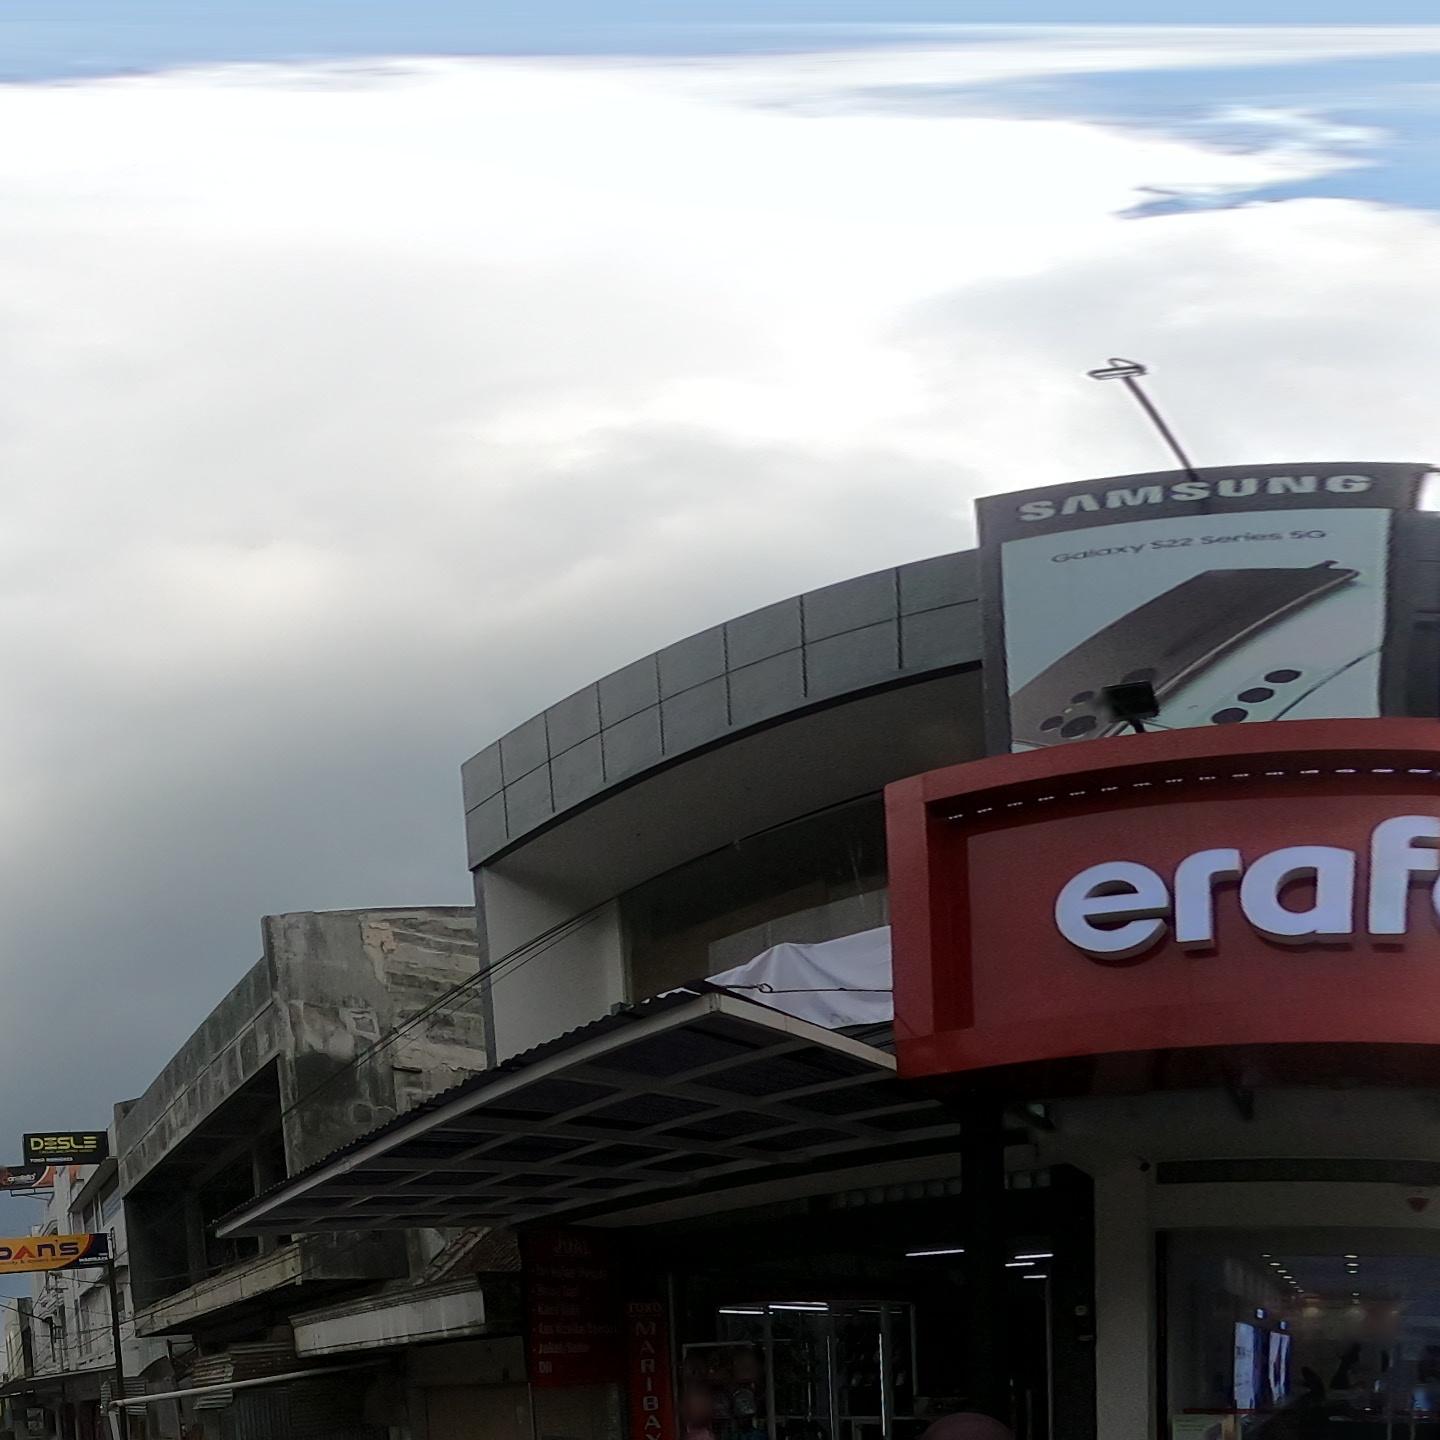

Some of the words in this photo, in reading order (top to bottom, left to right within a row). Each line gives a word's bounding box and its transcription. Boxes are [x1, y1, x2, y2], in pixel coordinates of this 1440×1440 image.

[1018, 474, 1374, 522] SAMSUNG
[1050, 544, 1145, 564] Galaxy
[1149, 536, 1194, 551] S22
[1199, 529, 1284, 545] Series
[1288, 529, 1327, 540] 5G
